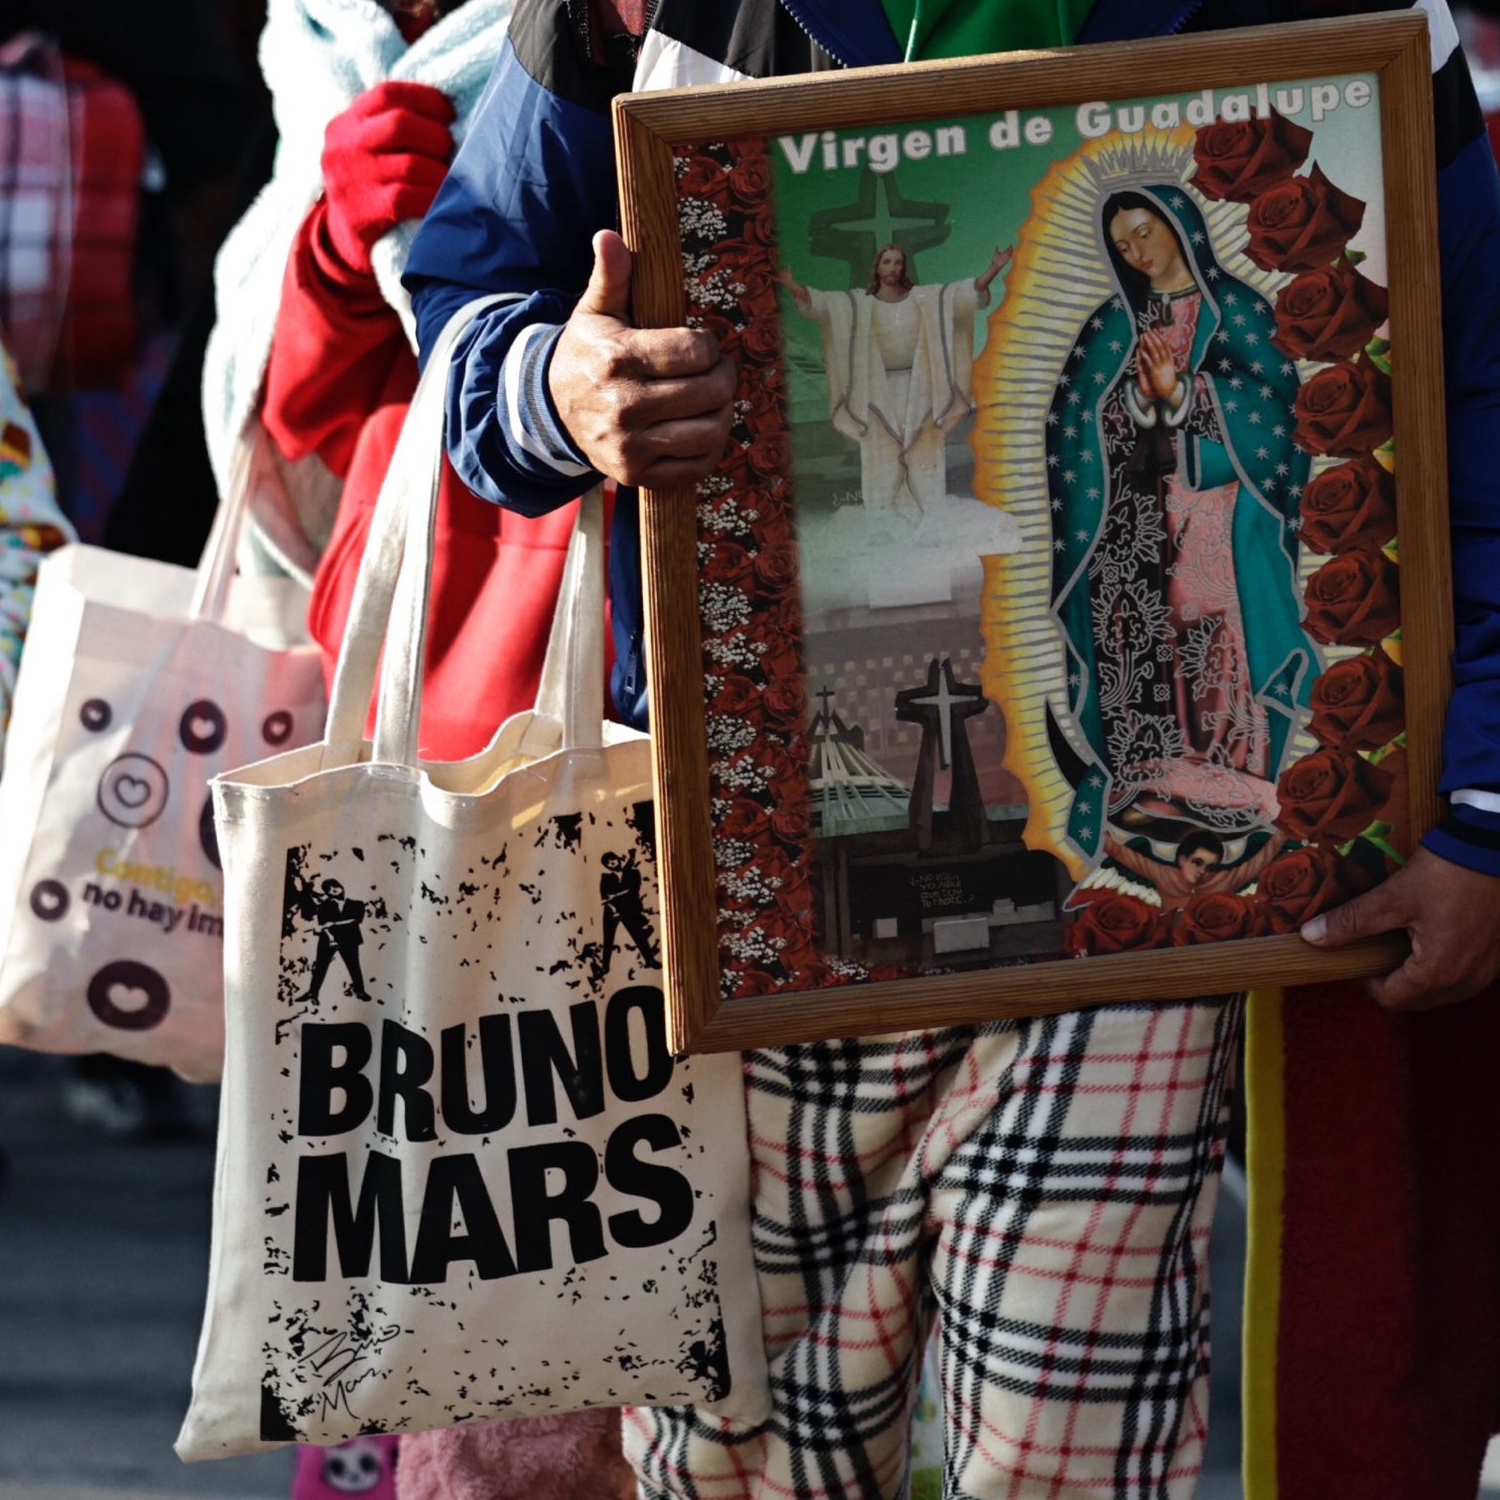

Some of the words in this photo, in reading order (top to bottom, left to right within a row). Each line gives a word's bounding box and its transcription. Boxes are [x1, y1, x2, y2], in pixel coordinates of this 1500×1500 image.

[778, 124, 966, 173] Virgen
[990, 111, 1053, 149] de
[1076, 79, 1373, 138] Guadalupe
[82, 882, 122, 911] no
[127, 887, 184, 933] hay
[298, 985, 675, 1142] BRUNO
[293, 1113, 694, 1284] MARS
